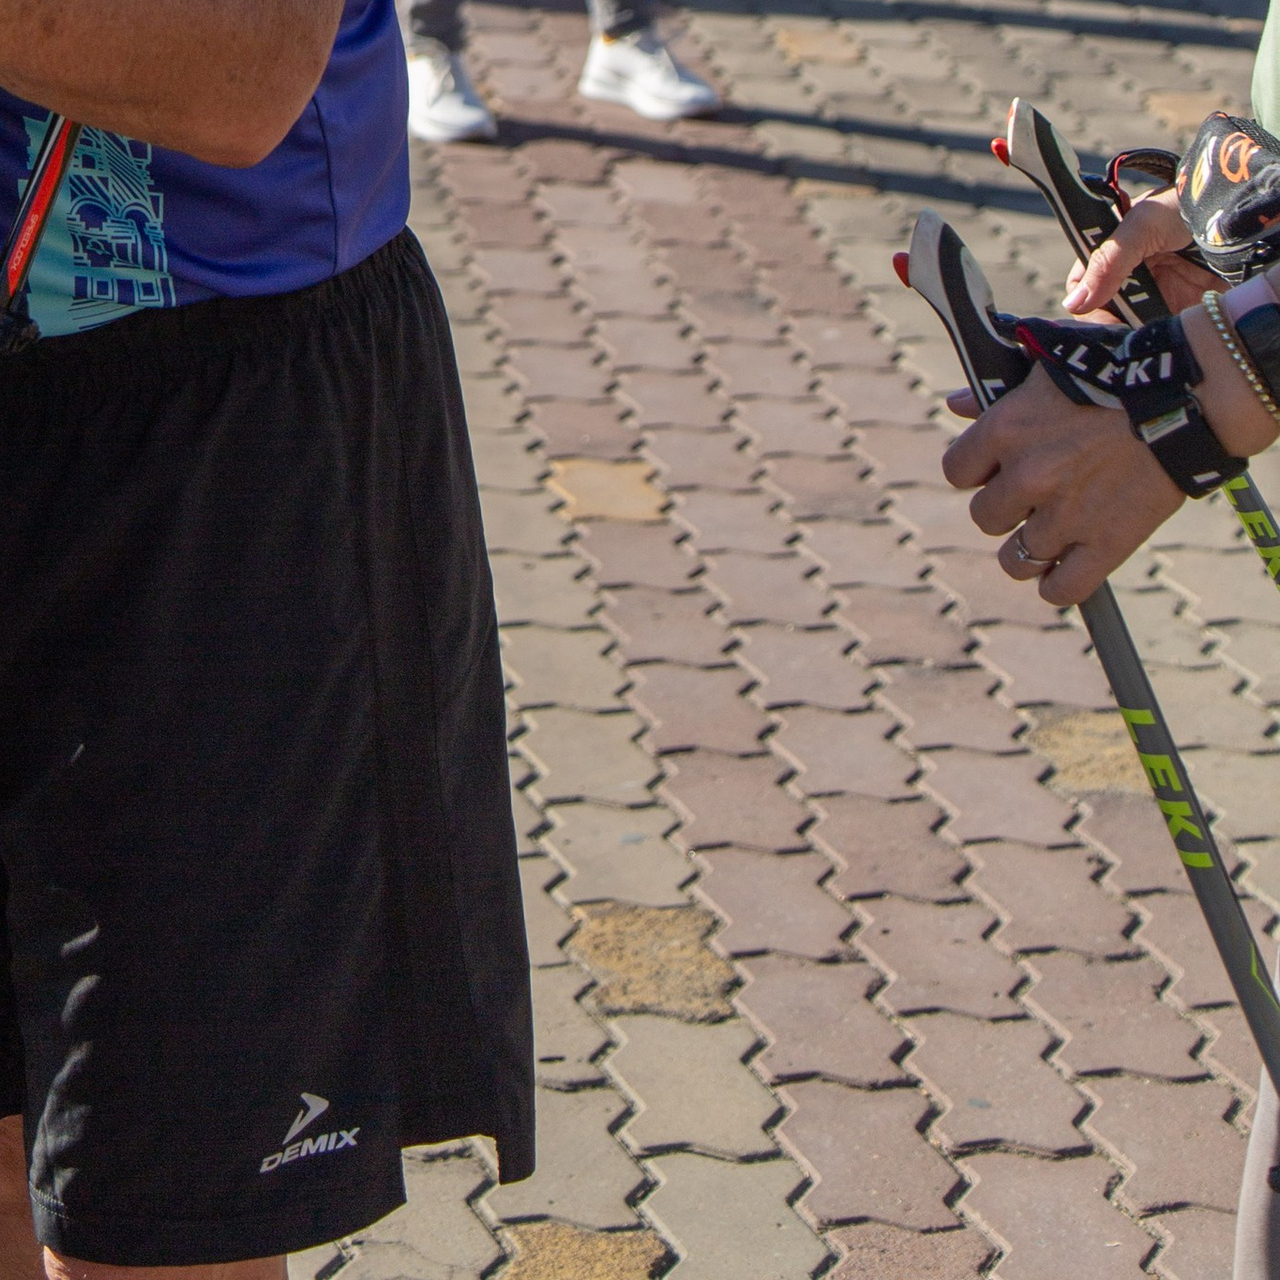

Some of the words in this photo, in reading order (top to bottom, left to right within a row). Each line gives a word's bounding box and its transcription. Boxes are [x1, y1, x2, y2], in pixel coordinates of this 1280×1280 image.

[1221, 475, 1280, 595] LEK
[1119, 706, 1215, 868] LEKI
[259, 1126, 361, 1175] DEMIX
